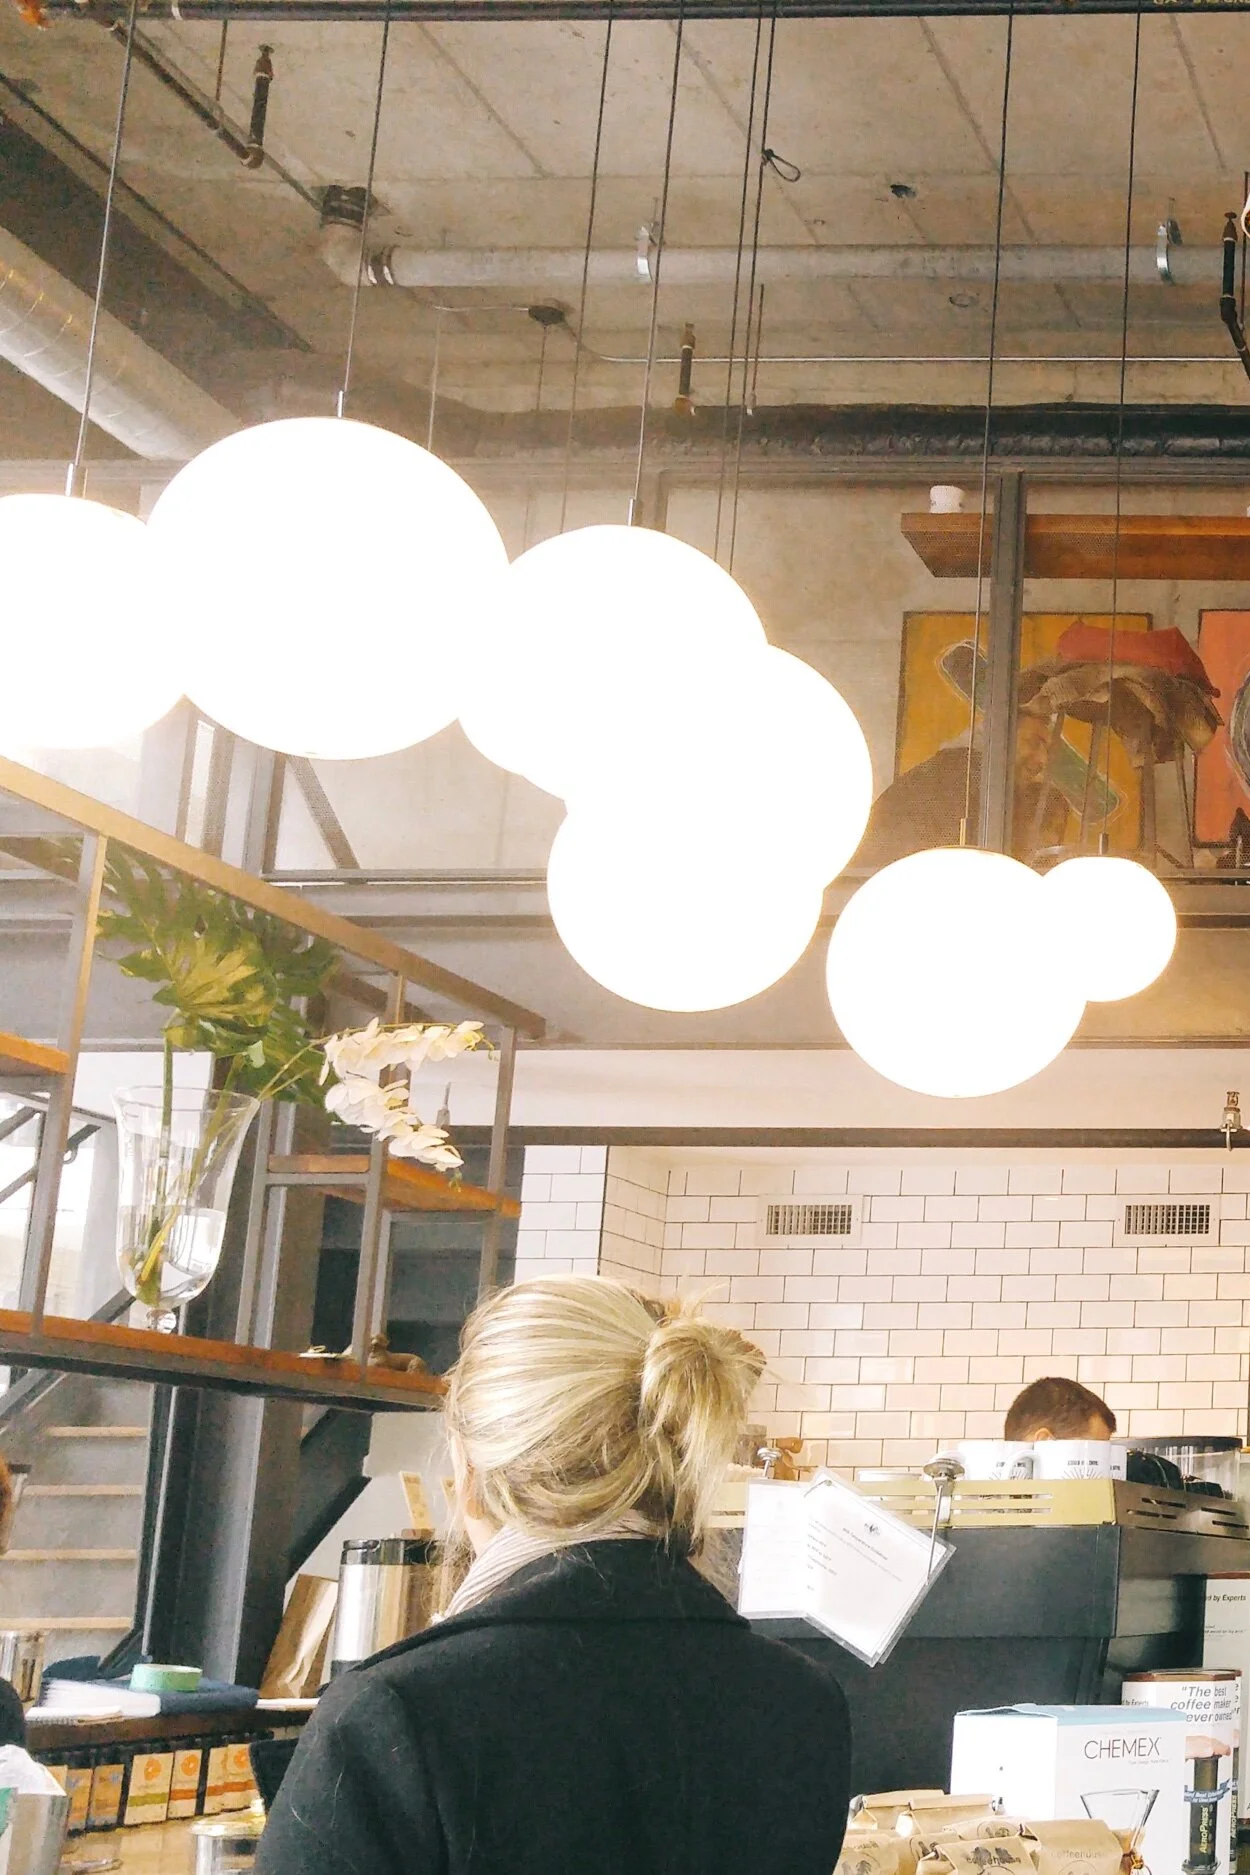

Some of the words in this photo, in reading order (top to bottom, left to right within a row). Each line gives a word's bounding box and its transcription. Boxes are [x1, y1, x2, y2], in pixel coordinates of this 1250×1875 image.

[1222, 1594, 1247, 1602] Experts
[1182, 1686, 1212, 1698] "The
[1170, 1699, 1212, 1710] coffee
[1186, 1713, 1213, 1722] ever
[1084, 1737, 1160, 1759] CHEMEX
